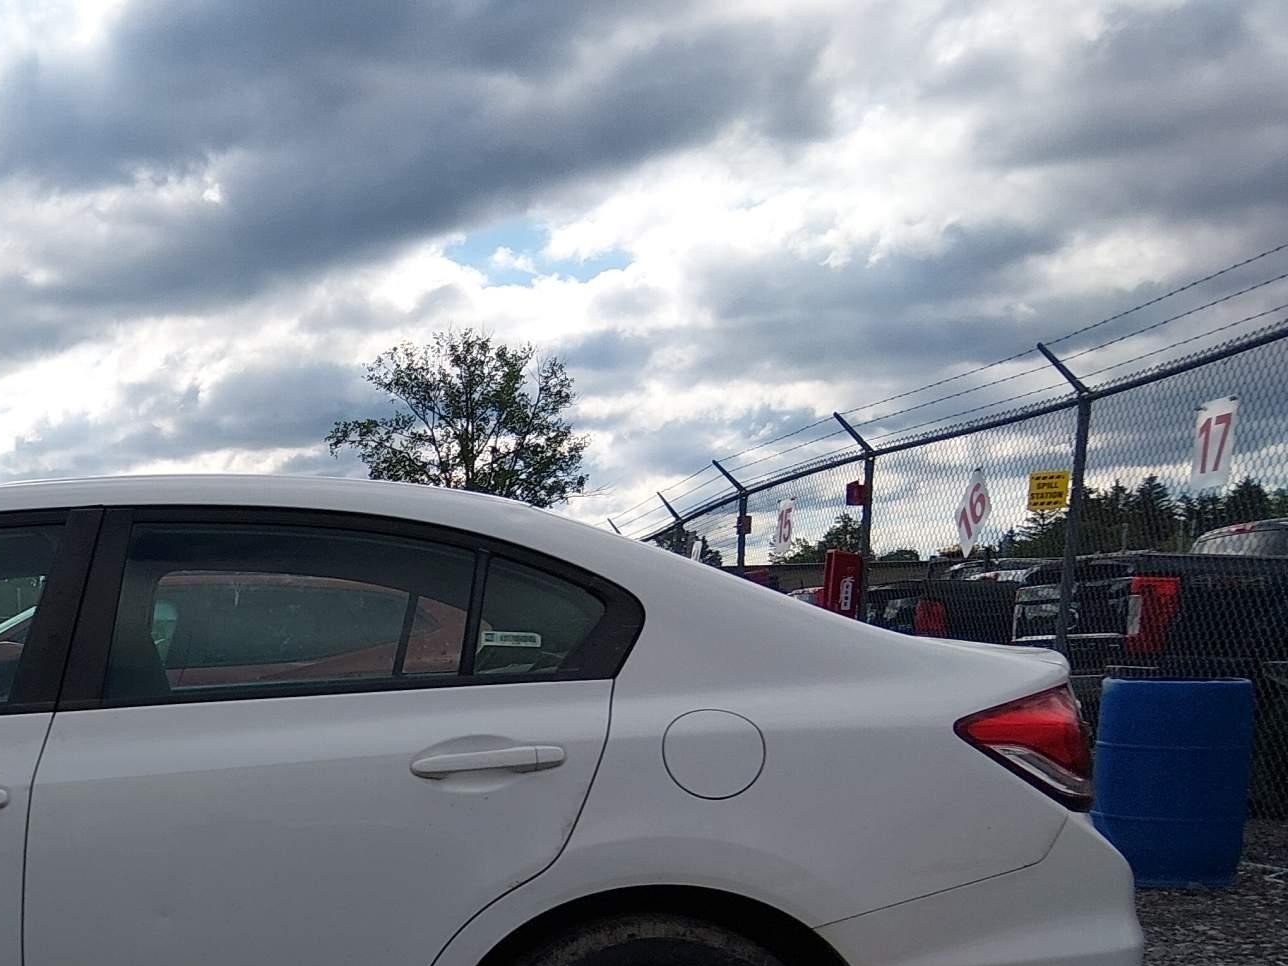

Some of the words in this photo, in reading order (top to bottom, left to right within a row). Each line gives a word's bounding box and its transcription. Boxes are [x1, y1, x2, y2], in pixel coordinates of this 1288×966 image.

[1198, 412, 1232, 474] 17
[1031, 491, 1064, 500] STATION
[1037, 482, 1059, 490] SPILL
[778, 507, 792, 544] 15
[958, 482, 986, 540] 16
